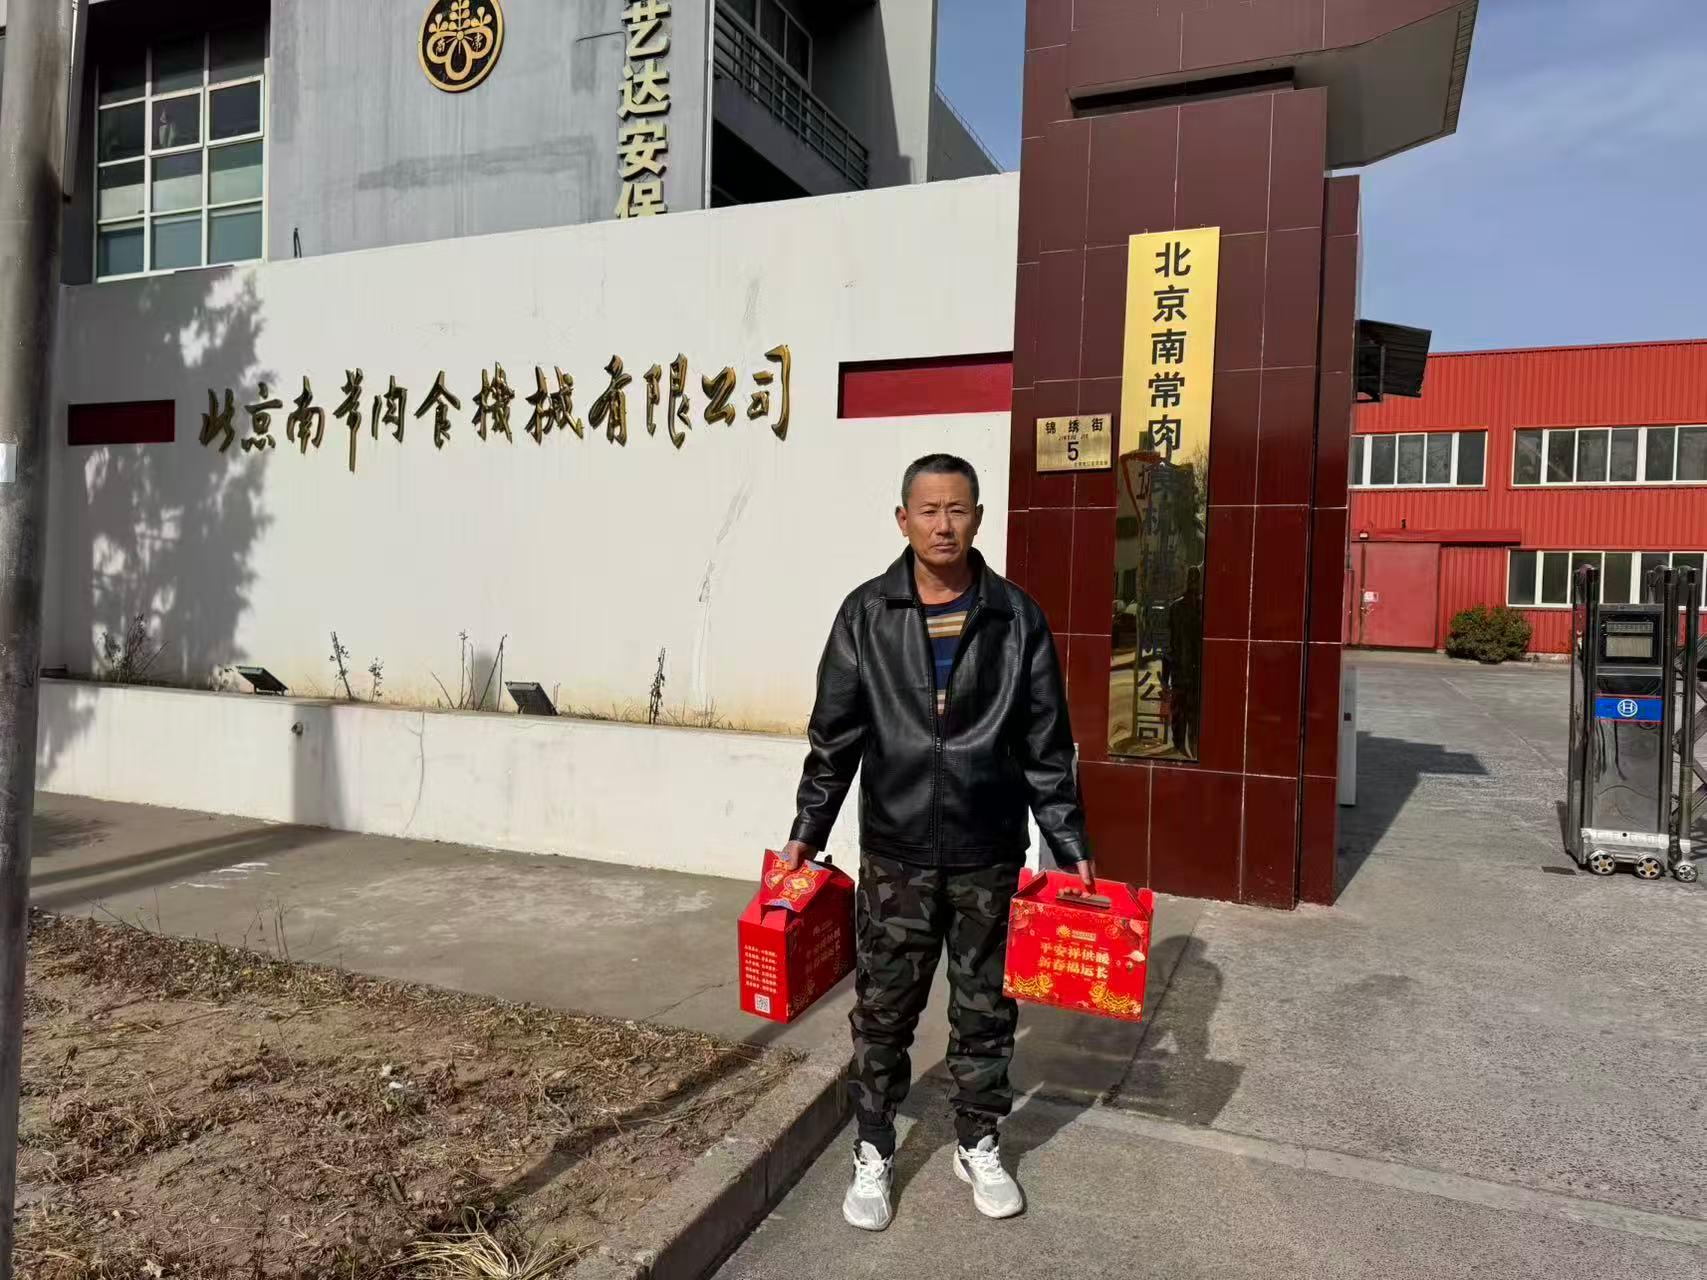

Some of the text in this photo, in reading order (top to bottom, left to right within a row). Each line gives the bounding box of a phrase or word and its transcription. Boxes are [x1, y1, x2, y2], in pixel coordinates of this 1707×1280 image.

[1045, 418, 1104, 434] 锦绣街
[1067, 441, 1079, 462] 5
